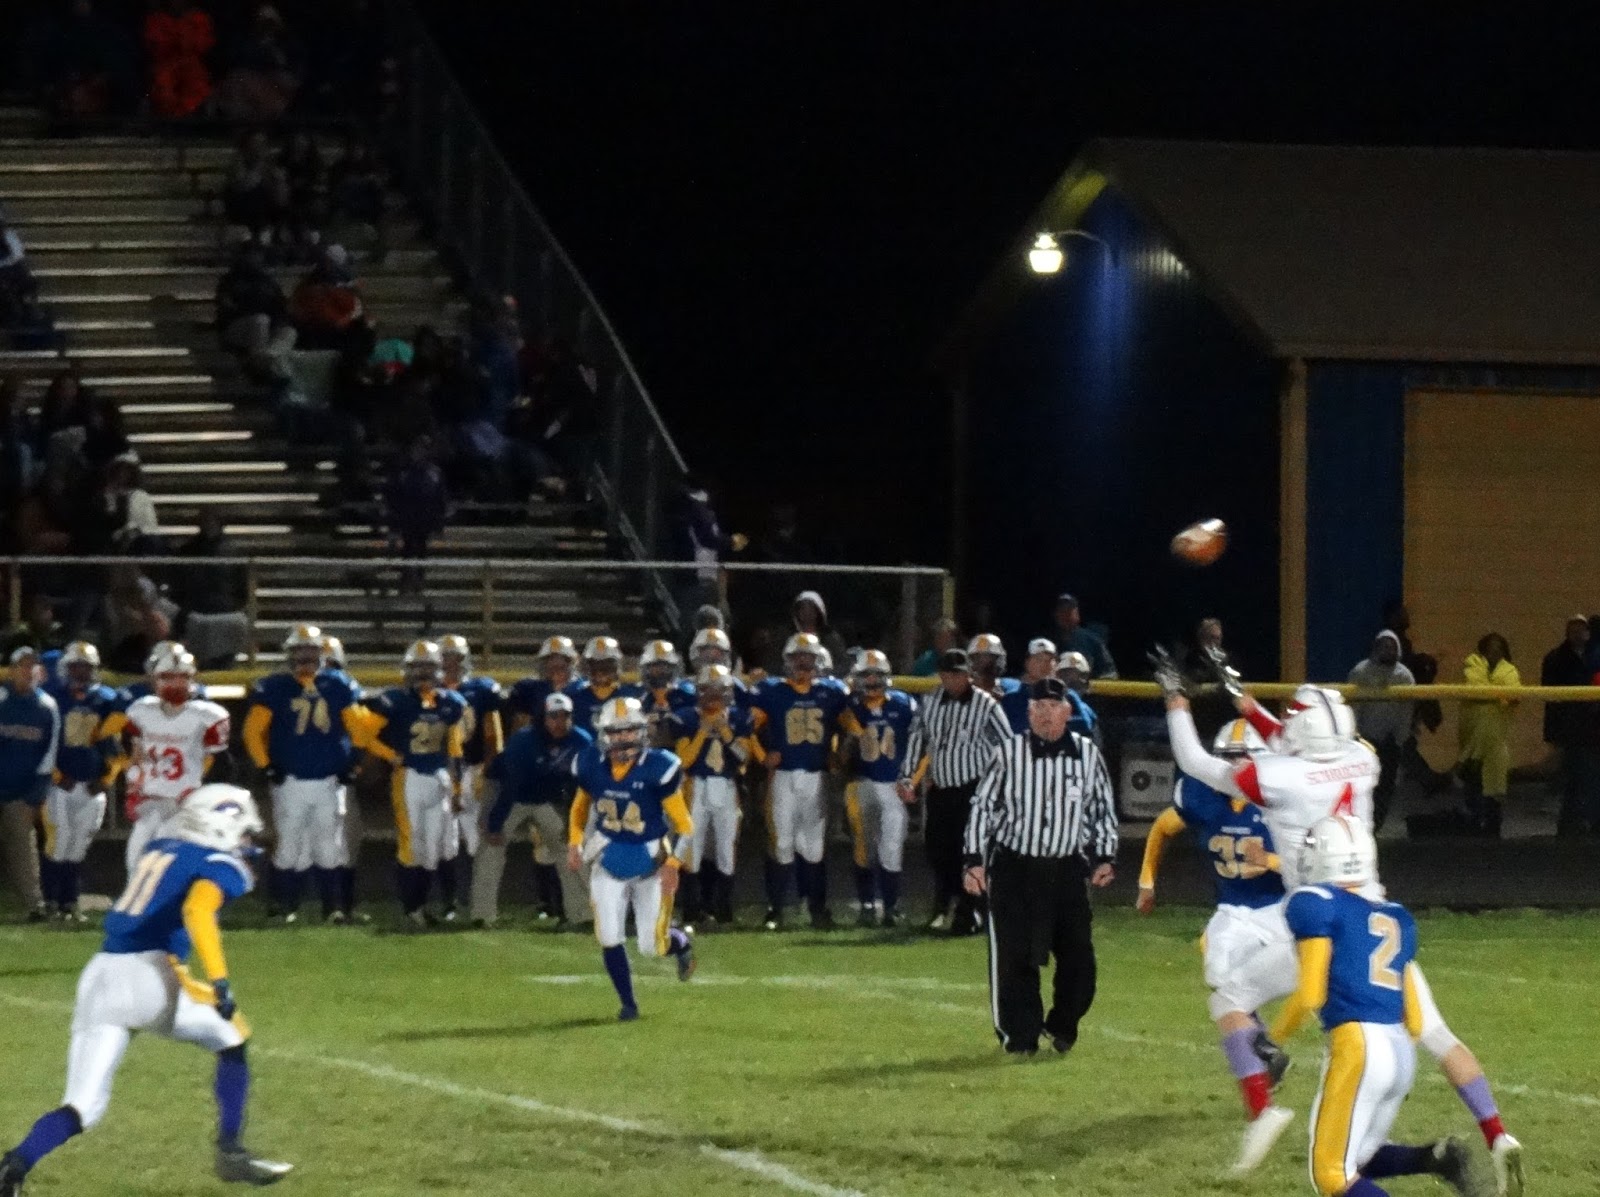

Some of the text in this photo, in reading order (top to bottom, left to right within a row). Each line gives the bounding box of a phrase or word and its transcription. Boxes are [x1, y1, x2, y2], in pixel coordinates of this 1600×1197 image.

[290, 697, 331, 735] 74
[147, 744, 184, 781] 13
[110, 850, 176, 917] 11
[1367, 911, 1401, 991] 2
